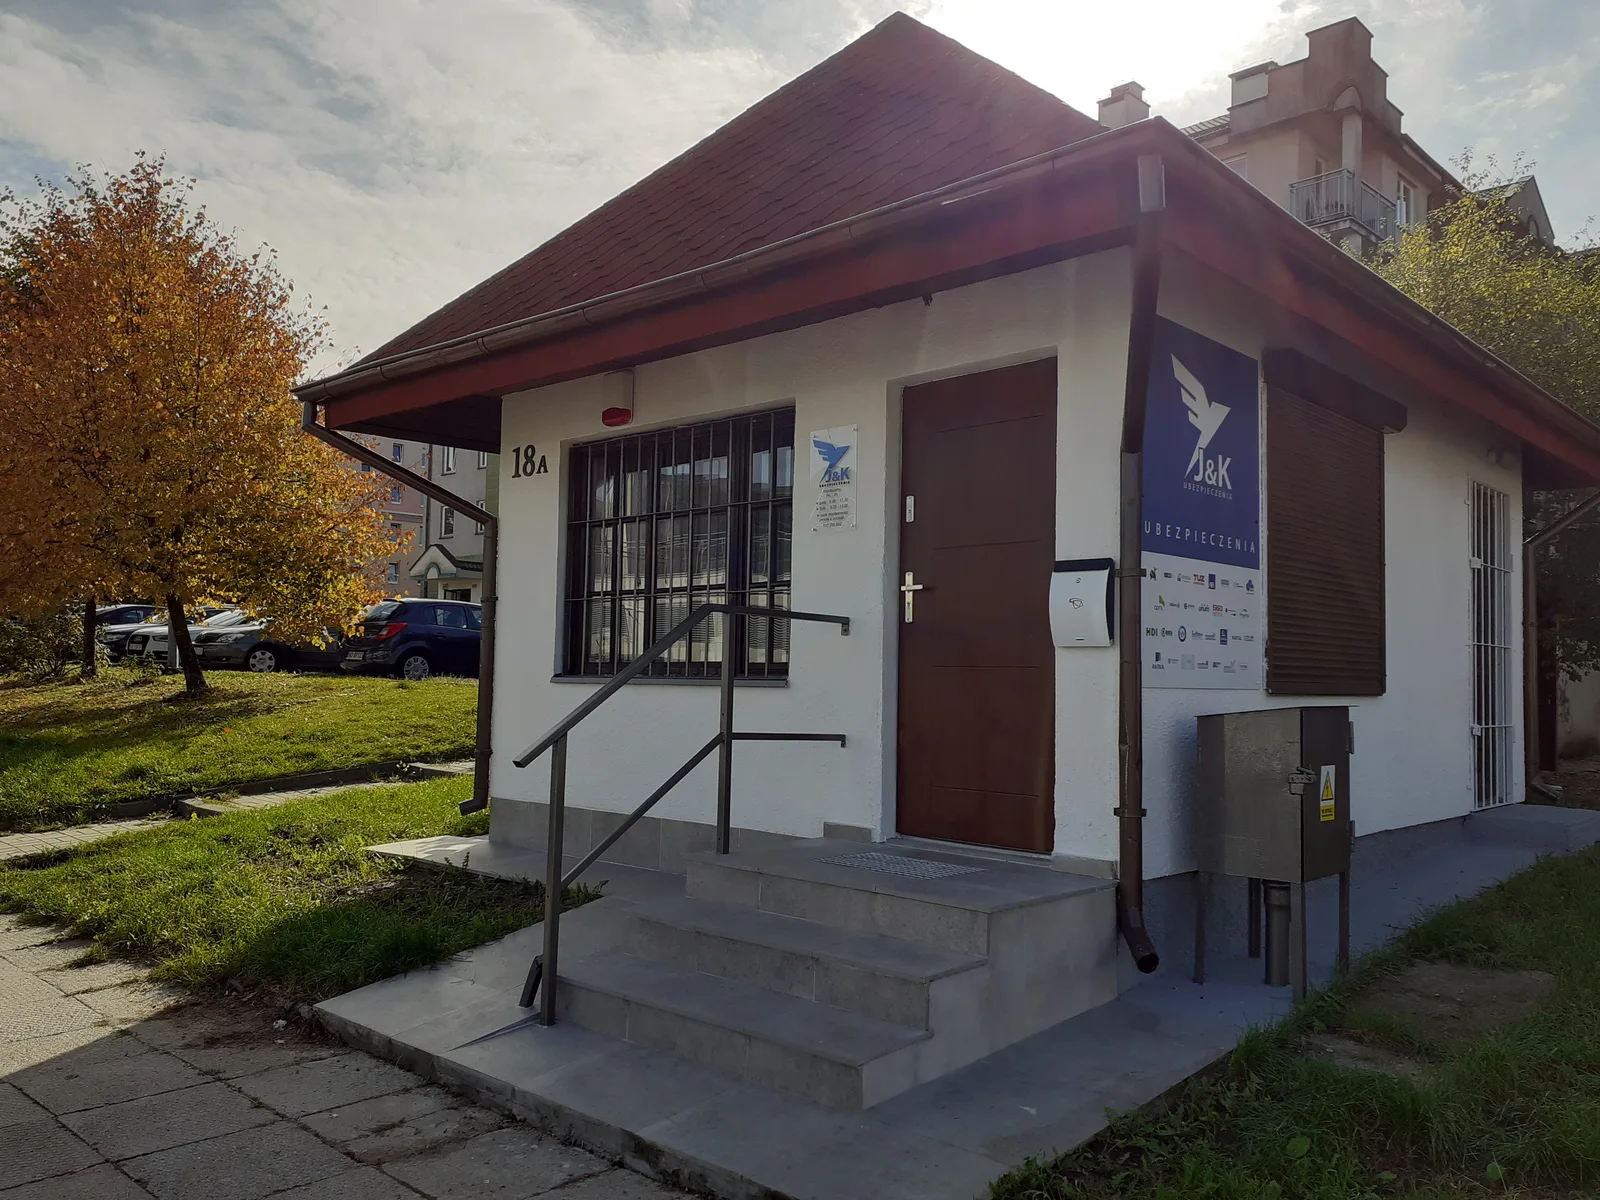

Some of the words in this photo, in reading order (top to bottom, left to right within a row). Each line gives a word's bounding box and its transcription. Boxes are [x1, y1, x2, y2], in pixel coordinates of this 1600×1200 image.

[511, 444, 549, 479] 18A
[824, 466, 850, 483] J&K
[1193, 448, 1233, 490] J&K
[1183, 481, 1233, 500] UBEZPIECZENIA
[1143, 520, 1256, 553] UBEZPIECZENIA
[1145, 627, 1158, 637] HDI
